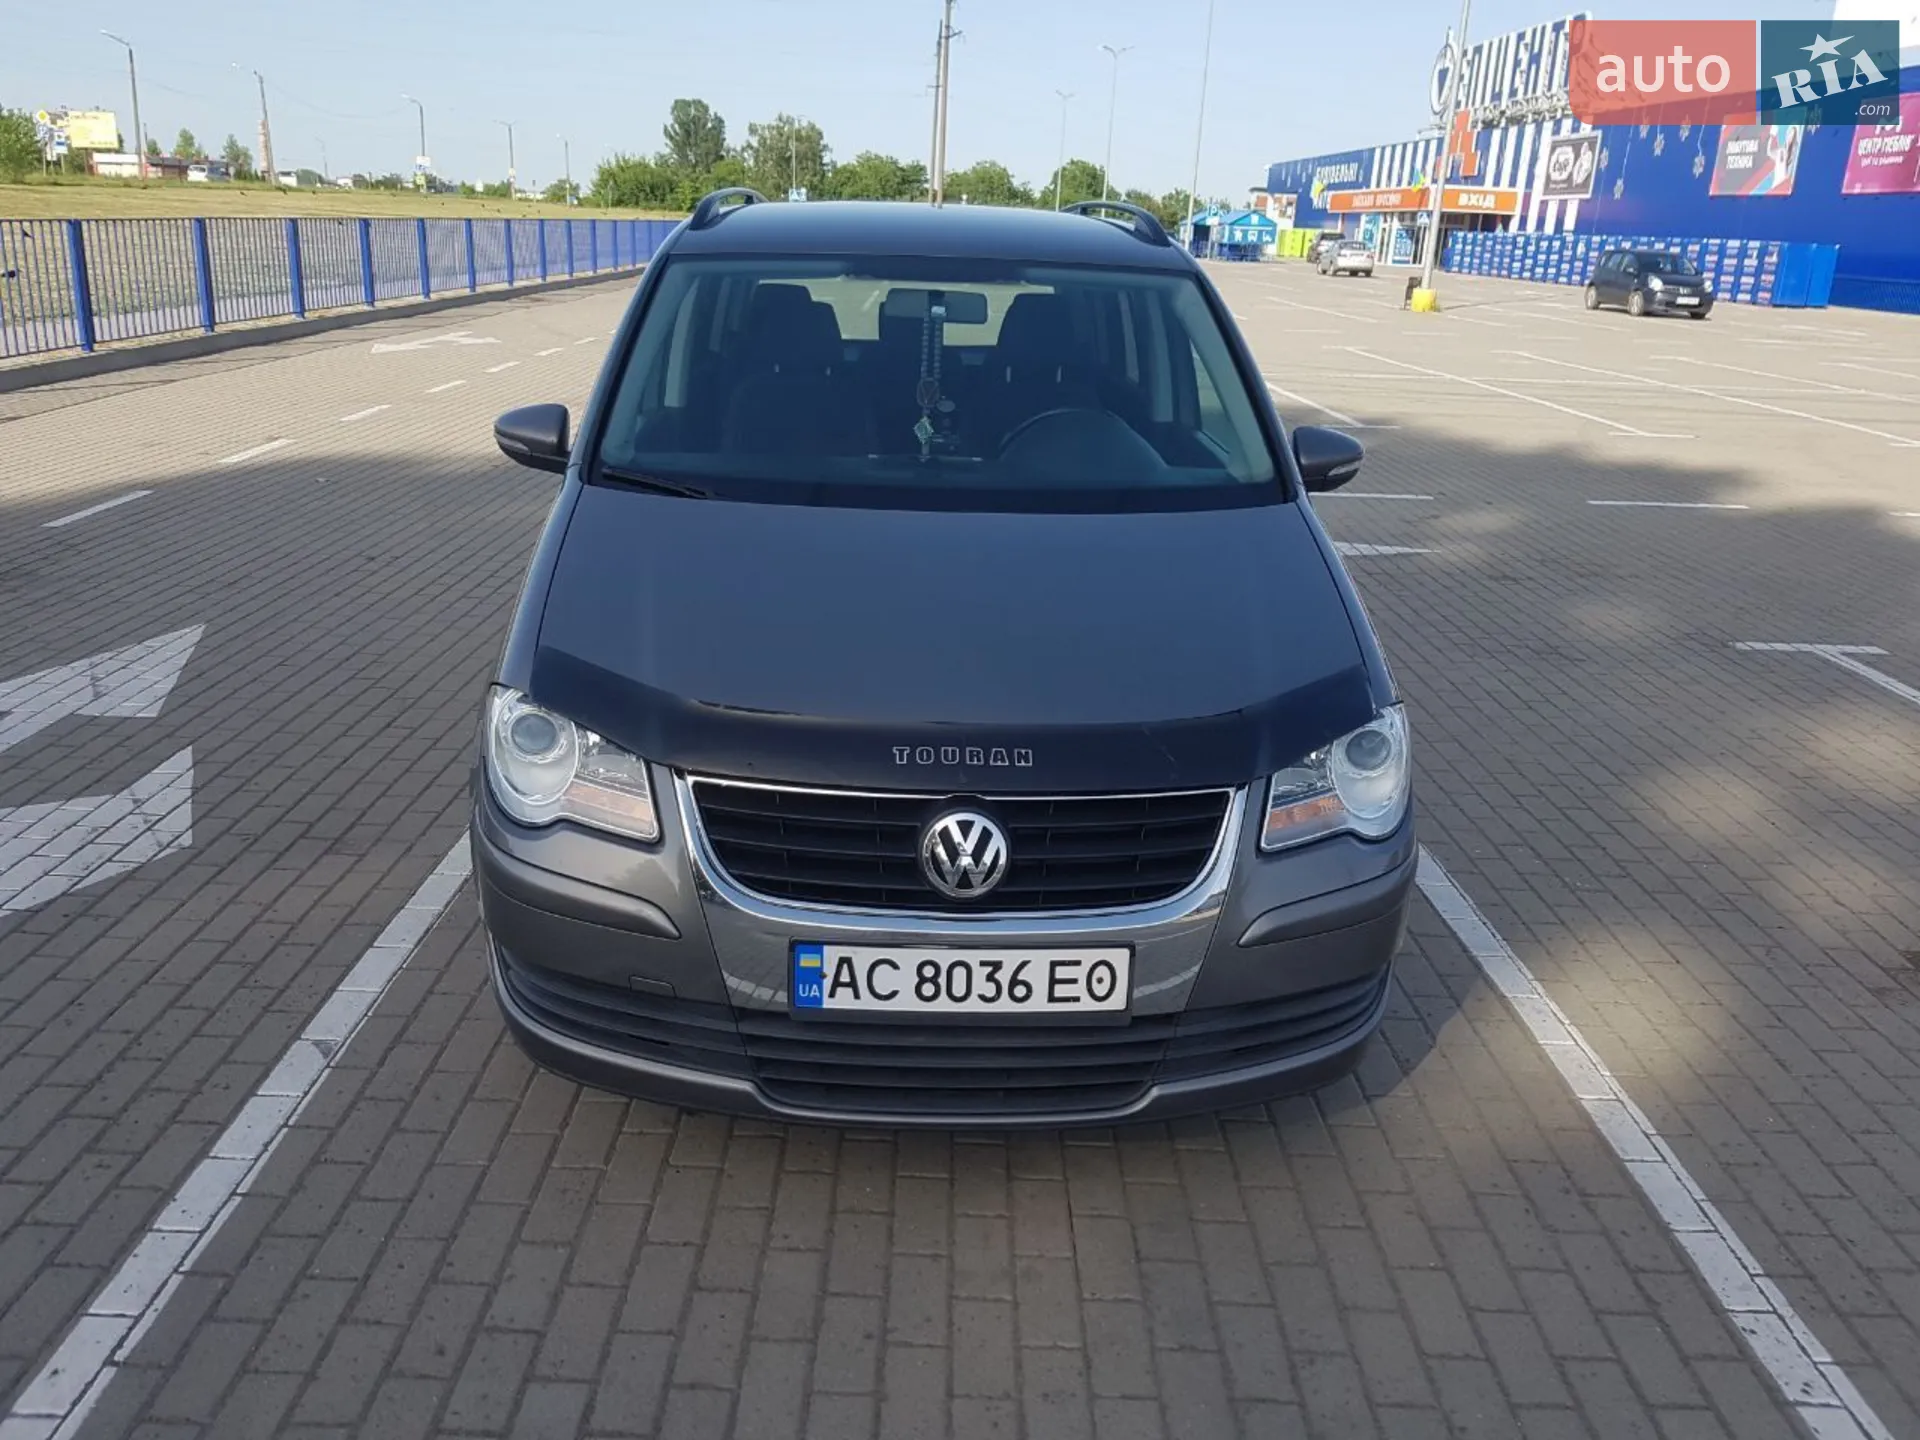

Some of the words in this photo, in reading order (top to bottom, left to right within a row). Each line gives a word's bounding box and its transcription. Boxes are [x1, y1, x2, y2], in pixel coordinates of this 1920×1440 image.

[1457, 193, 1496, 209] ВХІД
[892, 746, 1033, 767] TOURAN
[923, 813, 1006, 897] VW
[828, 956, 901, 1001] AC
[914, 959, 1033, 1003] 8036
[798, 983, 820, 998] UA
